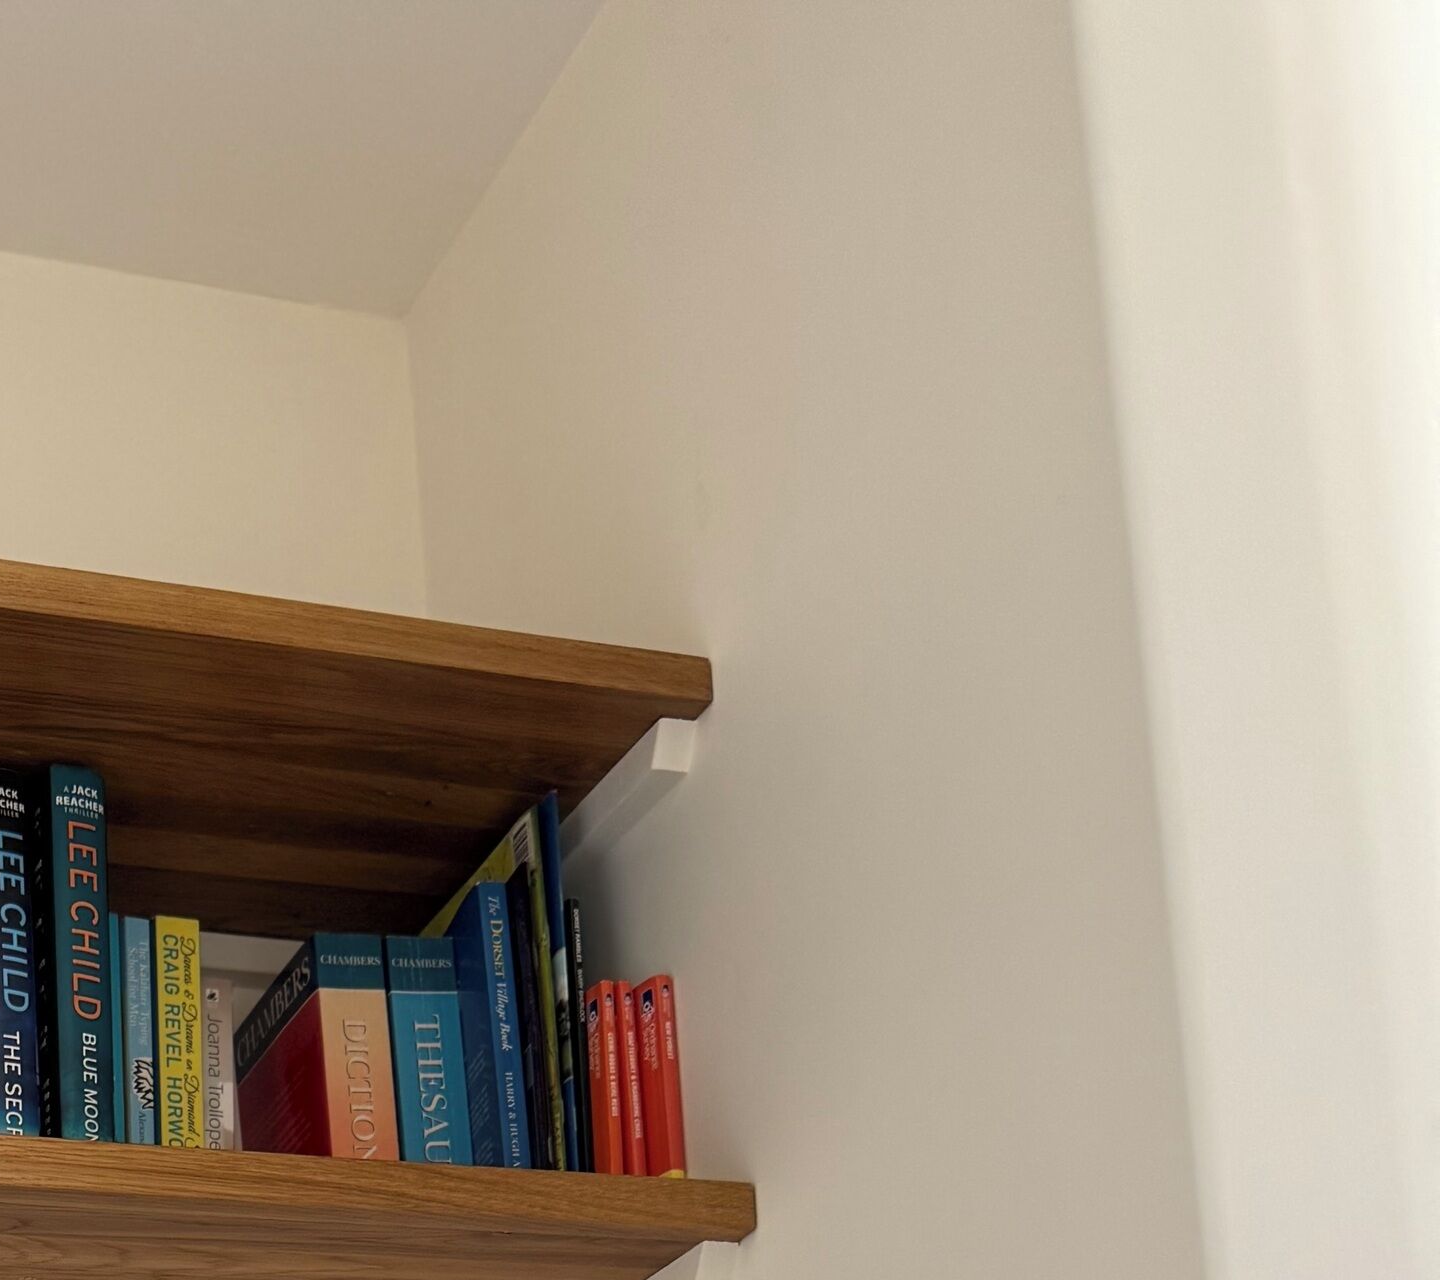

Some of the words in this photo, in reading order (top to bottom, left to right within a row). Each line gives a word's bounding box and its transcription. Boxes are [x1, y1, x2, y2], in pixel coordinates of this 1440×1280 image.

[56, 796, 104, 815] REACHER
[71, 785, 98, 799] JACK
[68, 820, 98, 892] LEE
[0, 903, 29, 1013] CHILD
[70, 901, 102, 1021] CHILD
[163, 934, 180, 995] CRAIG
[180, 936, 196, 986] Dances
[320, 954, 381, 967] CHAMBERS
[391, 957, 453, 969] CHAMBERS
[490, 919, 506, 979] DORSET
[236, 955, 310, 1067] CHAMBERS
[496, 980, 507, 1020] Village
[3, 1031, 21, 1076] THE
[164, 1003, 181, 1067] REVEL
[181, 1002, 198, 1060] Dreams
[207, 1013, 222, 1077] Joanna
[498, 1022, 513, 1052] Book
[82, 1033, 98, 1084] BLUE
[184, 1074, 200, 1138] Diamond
[505, 1072, 516, 1109] HARRY
[509, 1123, 520, 1157] HUGH
